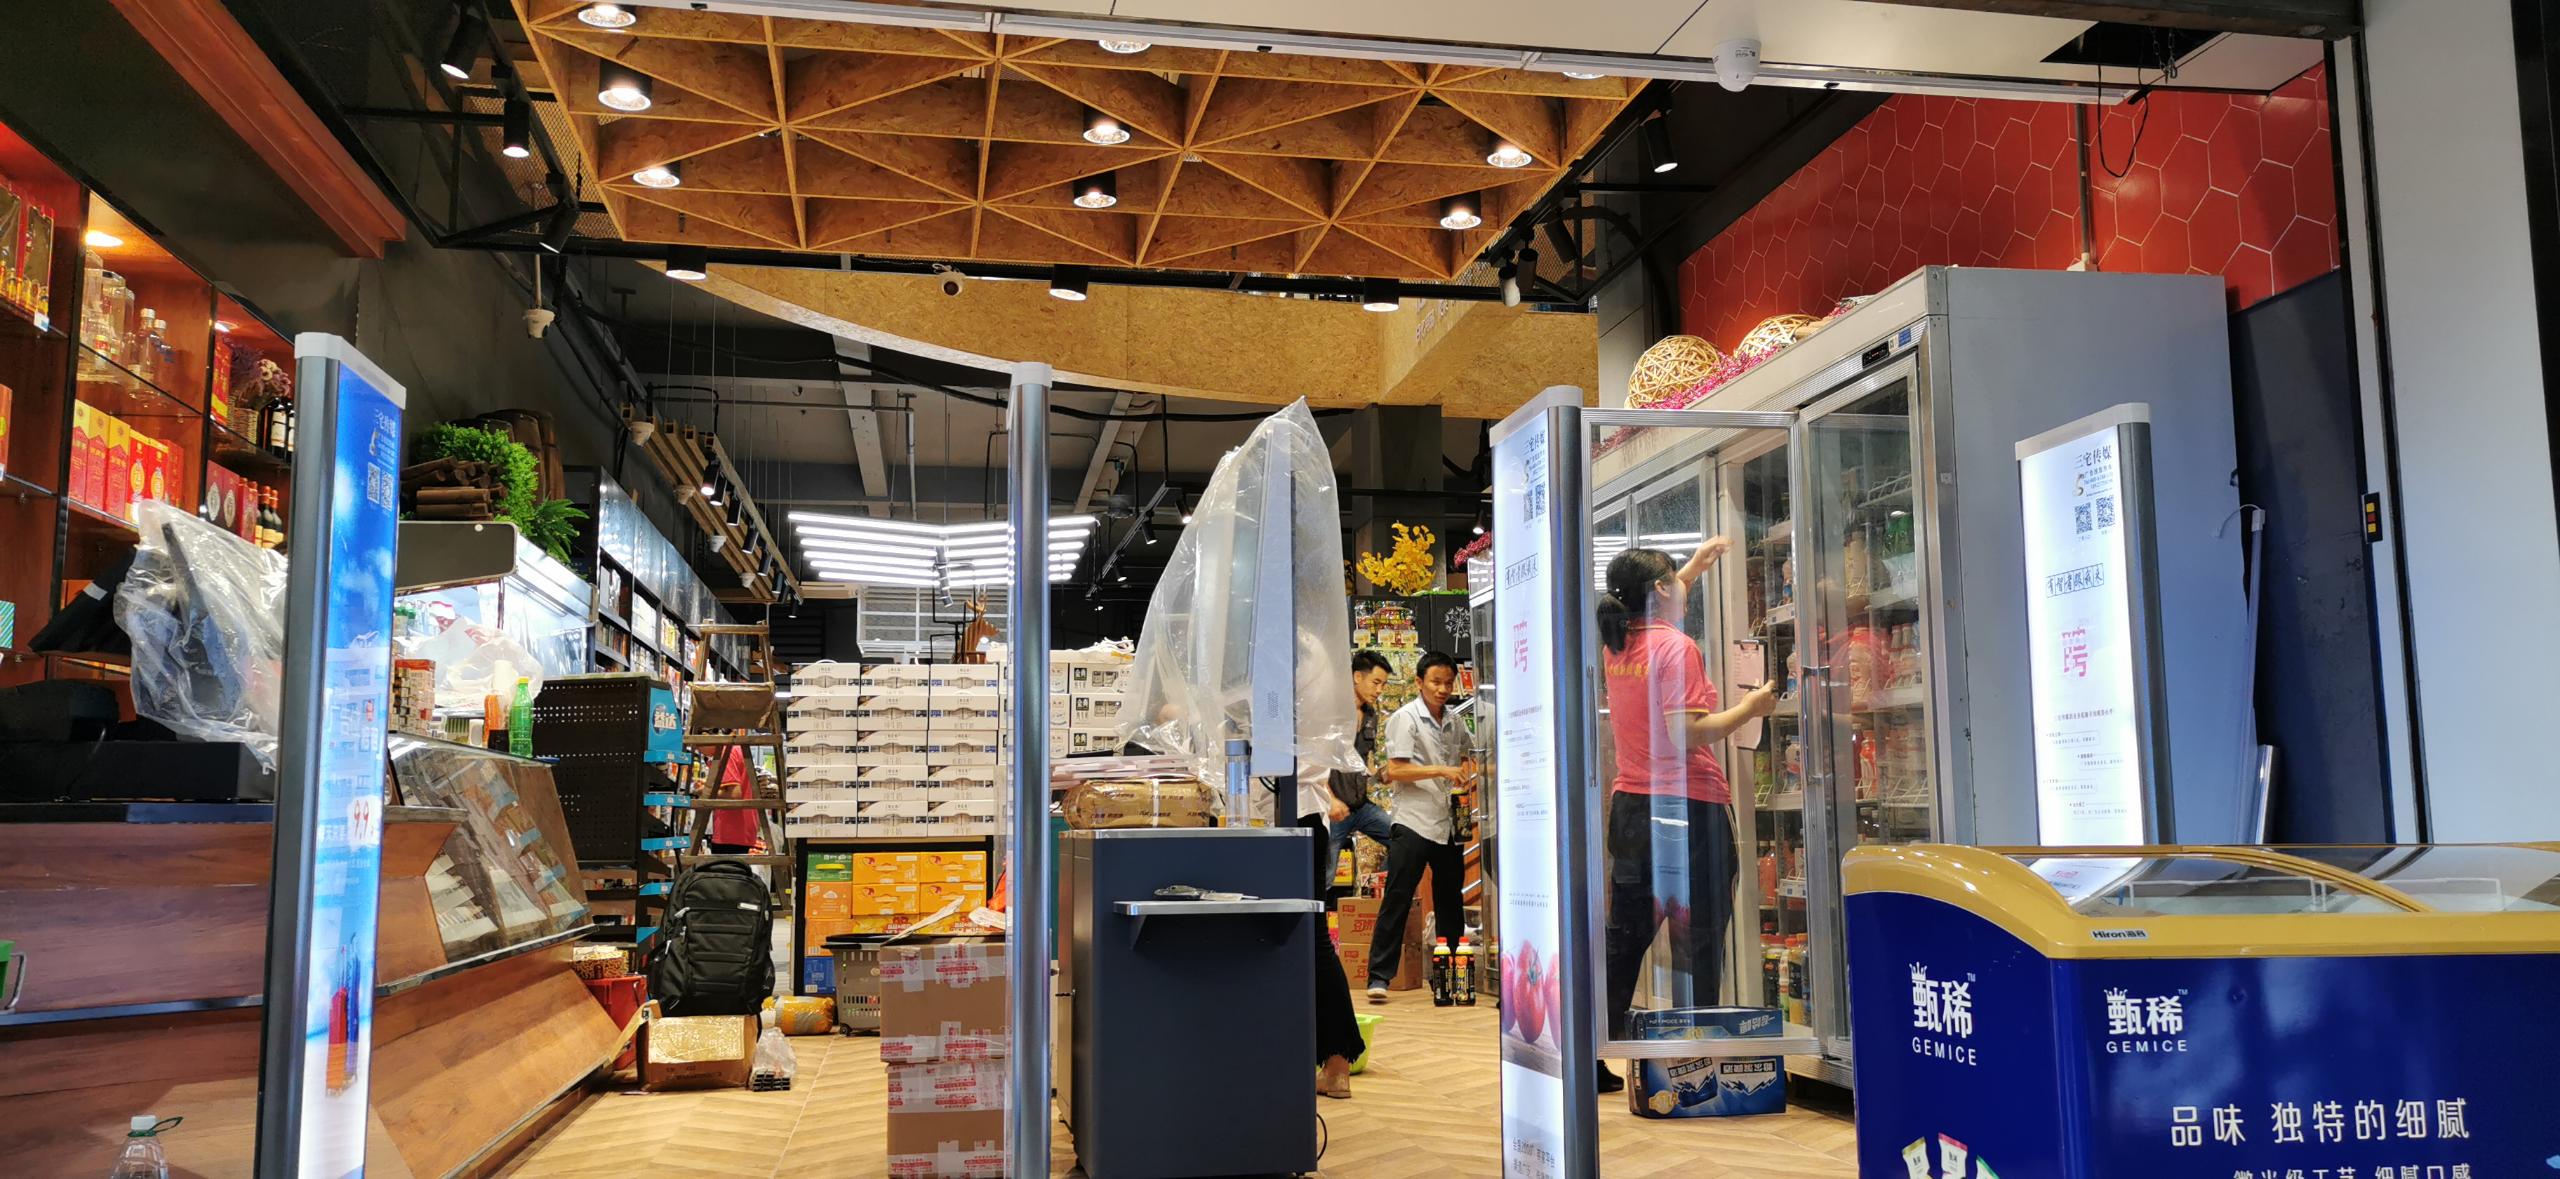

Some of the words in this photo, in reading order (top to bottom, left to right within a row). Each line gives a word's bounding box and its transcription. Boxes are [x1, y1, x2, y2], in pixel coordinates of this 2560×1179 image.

[2074, 445, 2112, 469] 三宅传媒
[1911, 973, 1973, 1039] 甄稀
[2106, 991, 2184, 1036] 甄稀
[1911, 1036, 1978, 1067] GEMICE
[2105, 1039, 2188, 1054] GEMICE
[2170, 1103, 2247, 1147] 品味
[2270, 1096, 2471, 1144] 独特的细腻
